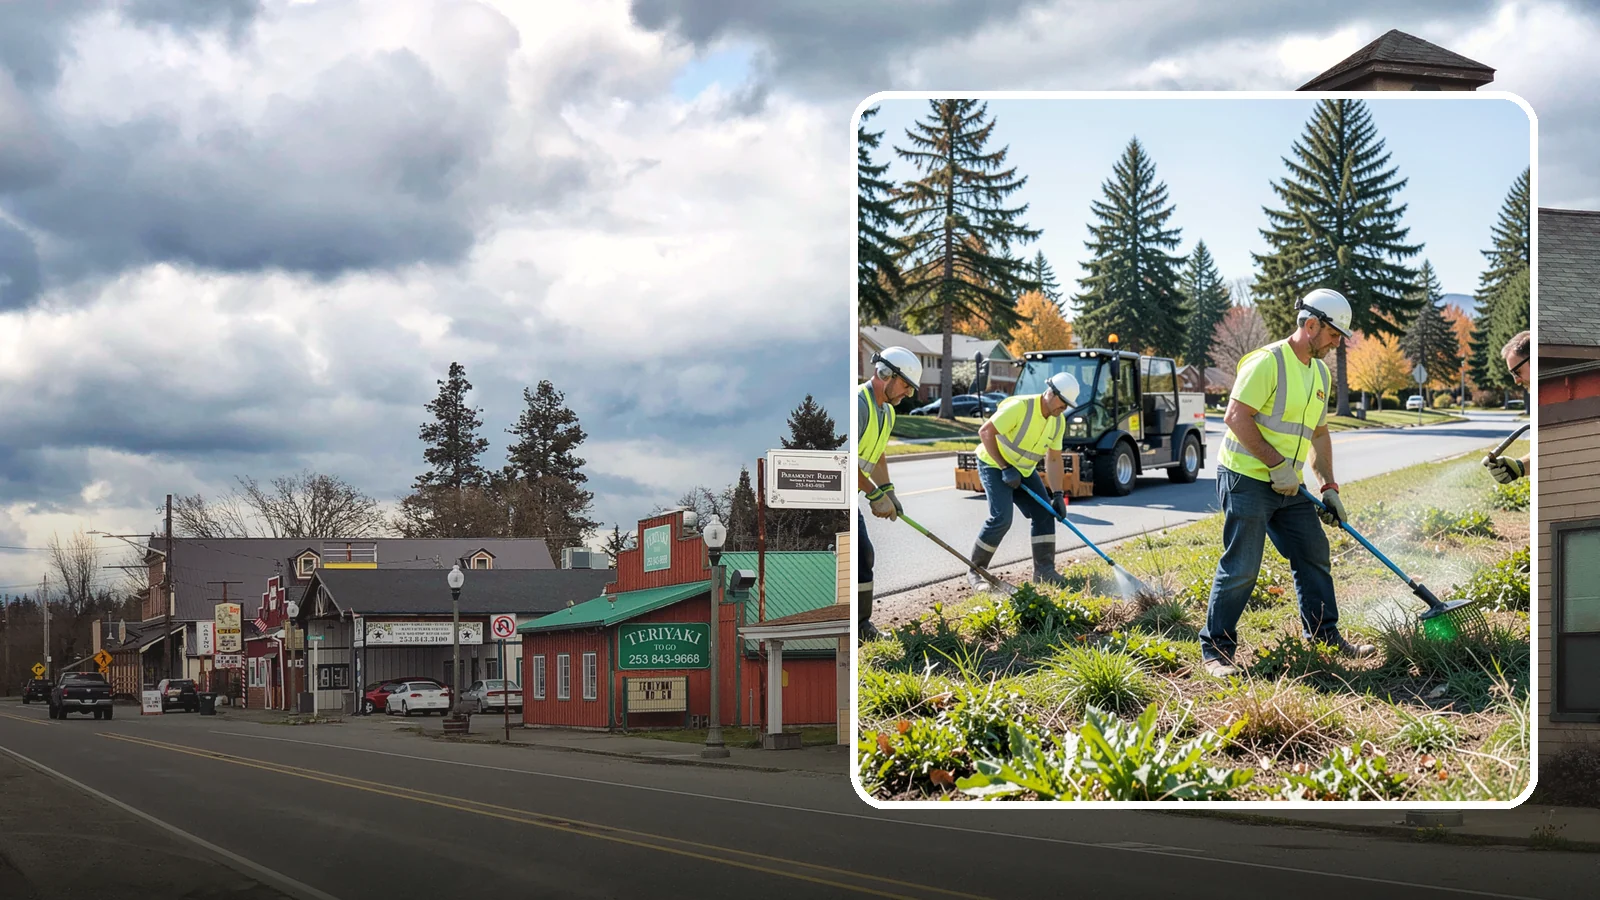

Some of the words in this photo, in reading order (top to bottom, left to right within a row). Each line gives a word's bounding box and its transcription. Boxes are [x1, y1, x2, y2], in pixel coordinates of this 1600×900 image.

[817, 472, 838, 480] REALTY
[624, 627, 702, 646] TERIYAKI
[629, 654, 648, 664] 253
[651, 653, 700, 664] 843-9668
